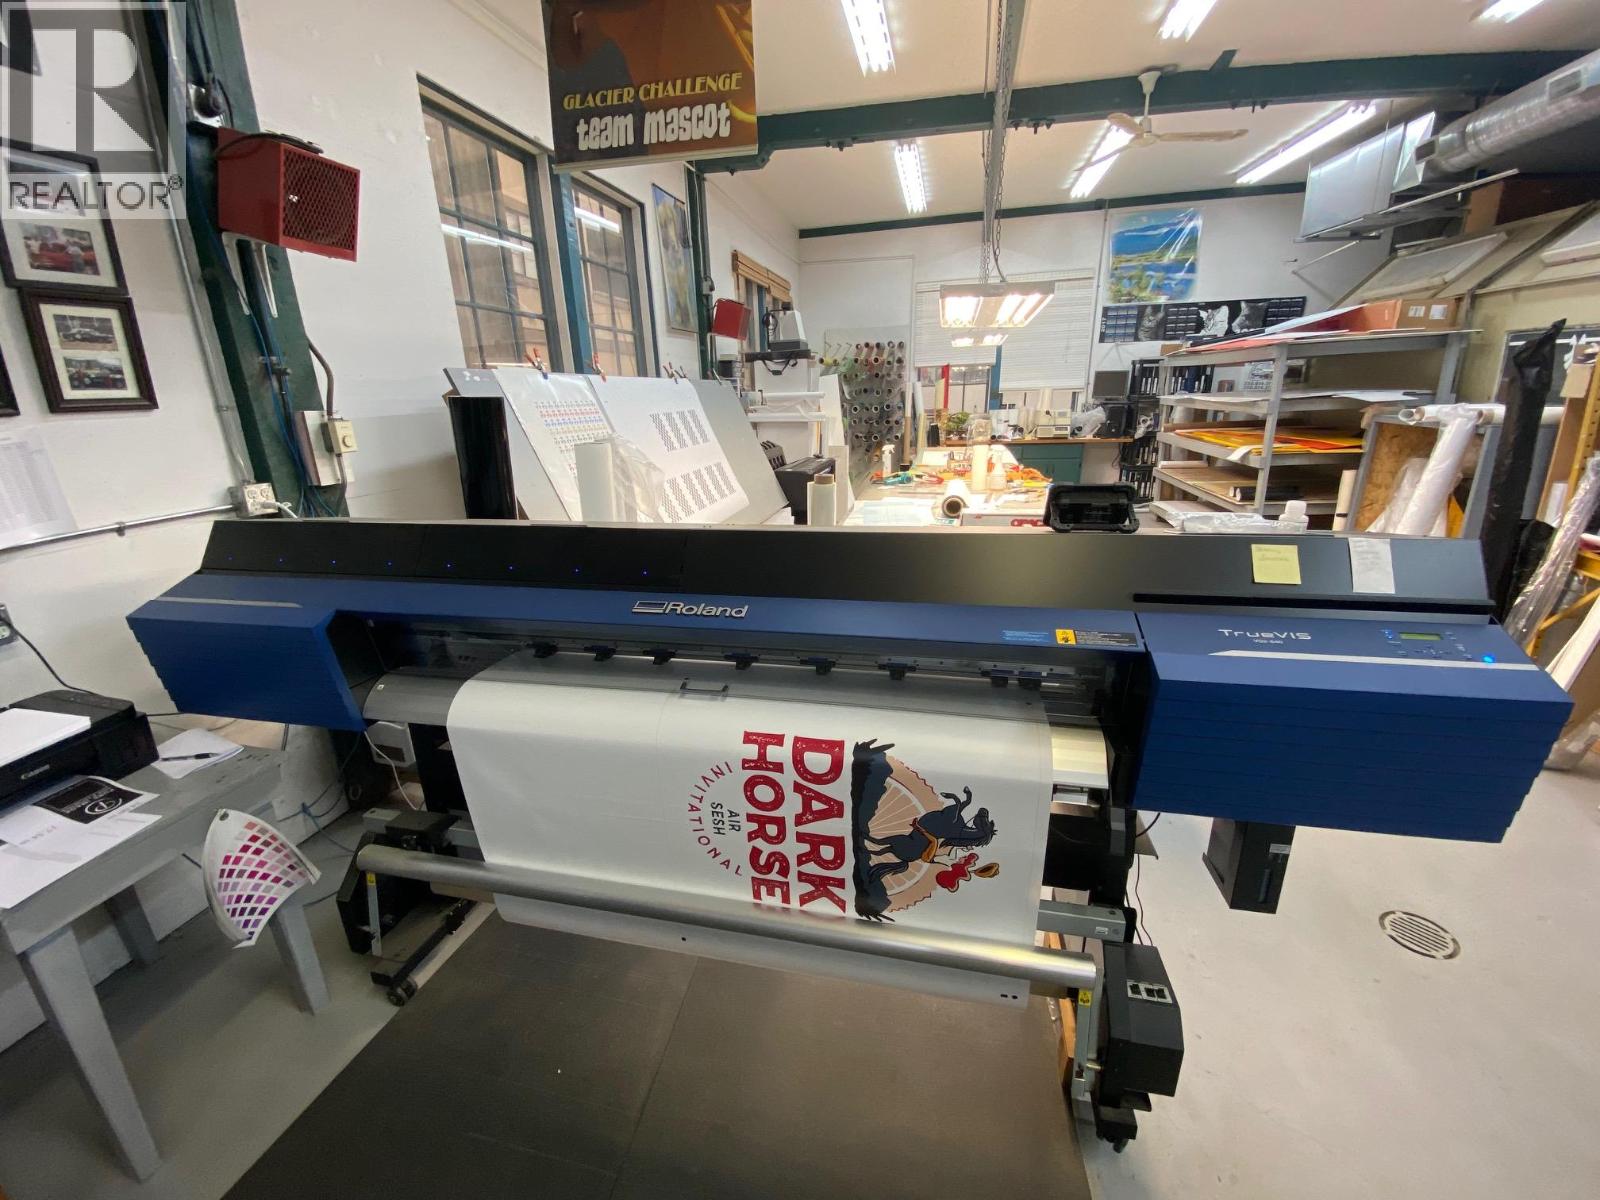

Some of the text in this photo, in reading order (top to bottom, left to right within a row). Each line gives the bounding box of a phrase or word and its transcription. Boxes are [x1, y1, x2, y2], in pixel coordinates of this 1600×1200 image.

[563, 72, 742, 110] GLACIER CHALLENGE
[576, 101, 731, 151] team mascot
[665, 601, 749, 618] Roland
[688, 761, 742, 876] INVITATIONAL
[710, 802, 726, 835] SESH
[727, 809, 741, 832] AIR
[741, 731, 791, 905] HORSE
[791, 736, 846, 914] DARK
